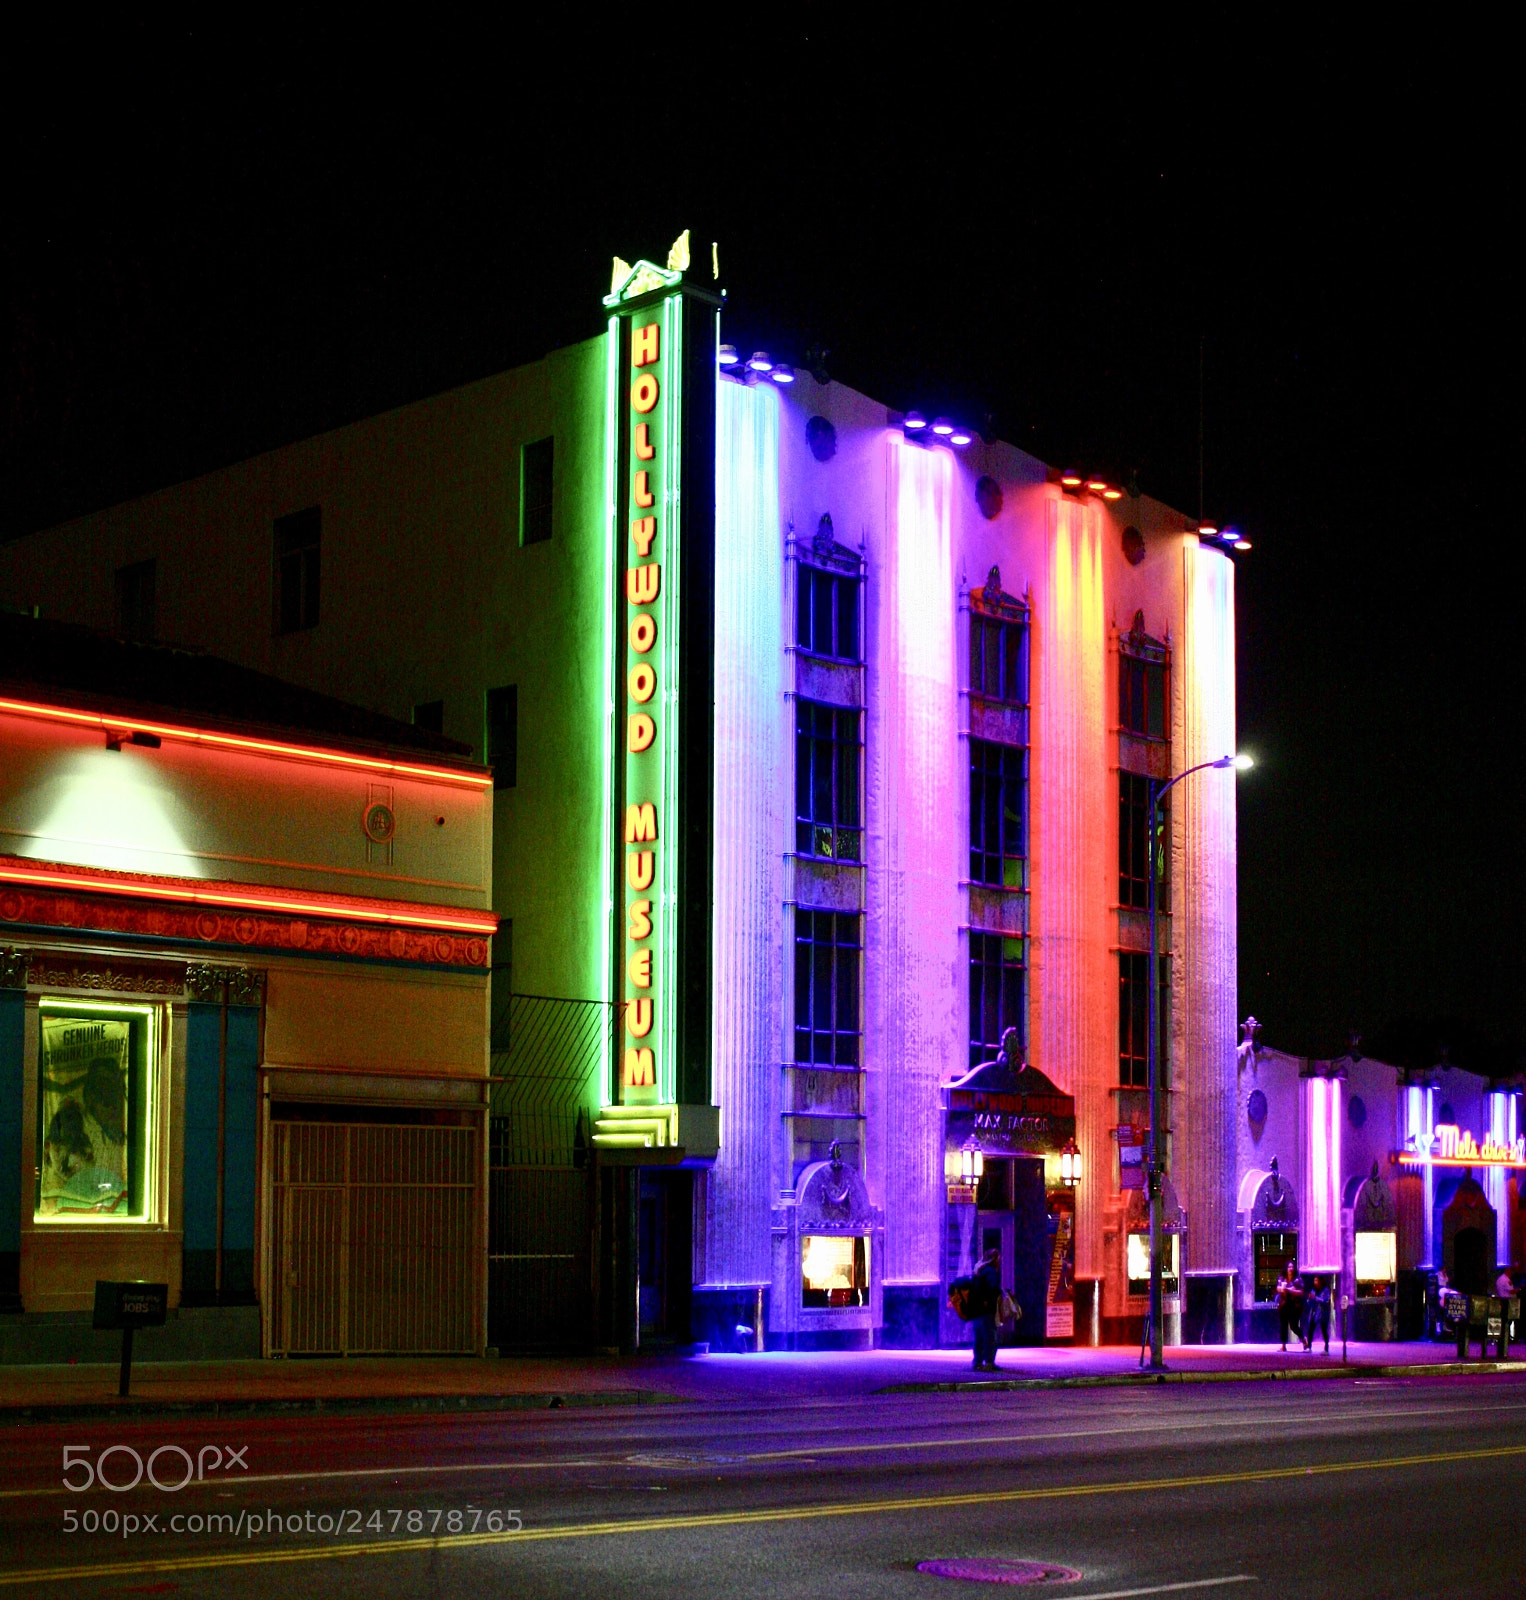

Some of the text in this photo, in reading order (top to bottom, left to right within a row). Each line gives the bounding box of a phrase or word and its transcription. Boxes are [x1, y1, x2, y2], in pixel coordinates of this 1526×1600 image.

[624, 323, 661, 1086] HOLLYWOOD MUSEUM
[63, 1024, 106, 1046] GENUINE
[44, 1043, 95, 1065] SHRUNKEN
[951, 1090, 1023, 1111] HOLLYWOOD
[974, 1113, 1049, 1131] MAX FACTOR
[1435, 1124, 1480, 1159] Mels
[122, 1303, 149, 1313] JOBS
